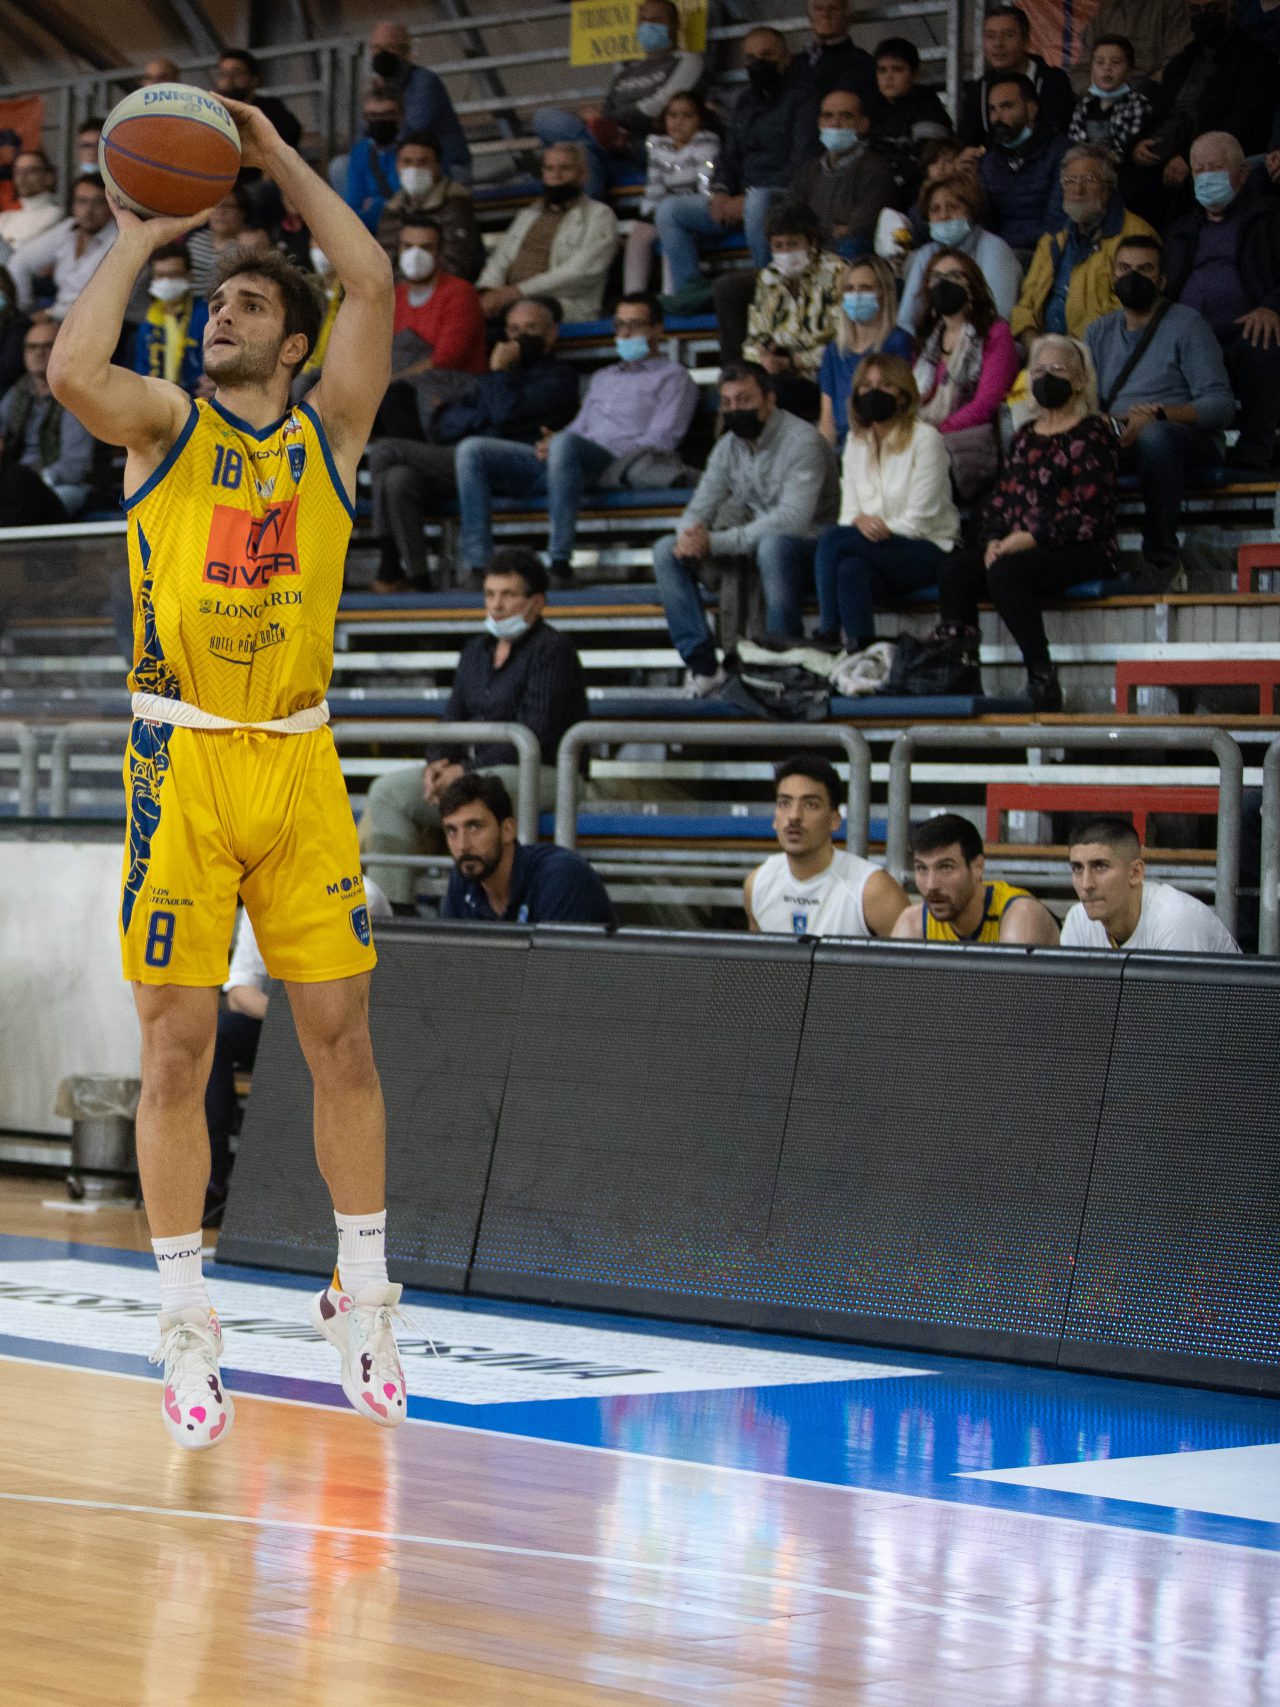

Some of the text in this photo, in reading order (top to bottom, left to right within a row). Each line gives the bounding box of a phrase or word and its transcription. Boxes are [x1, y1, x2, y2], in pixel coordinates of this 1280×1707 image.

[212, 443, 243, 490] 18
[206, 553, 296, 586] GIVOA
[209, 636, 234, 652] HOTEL
